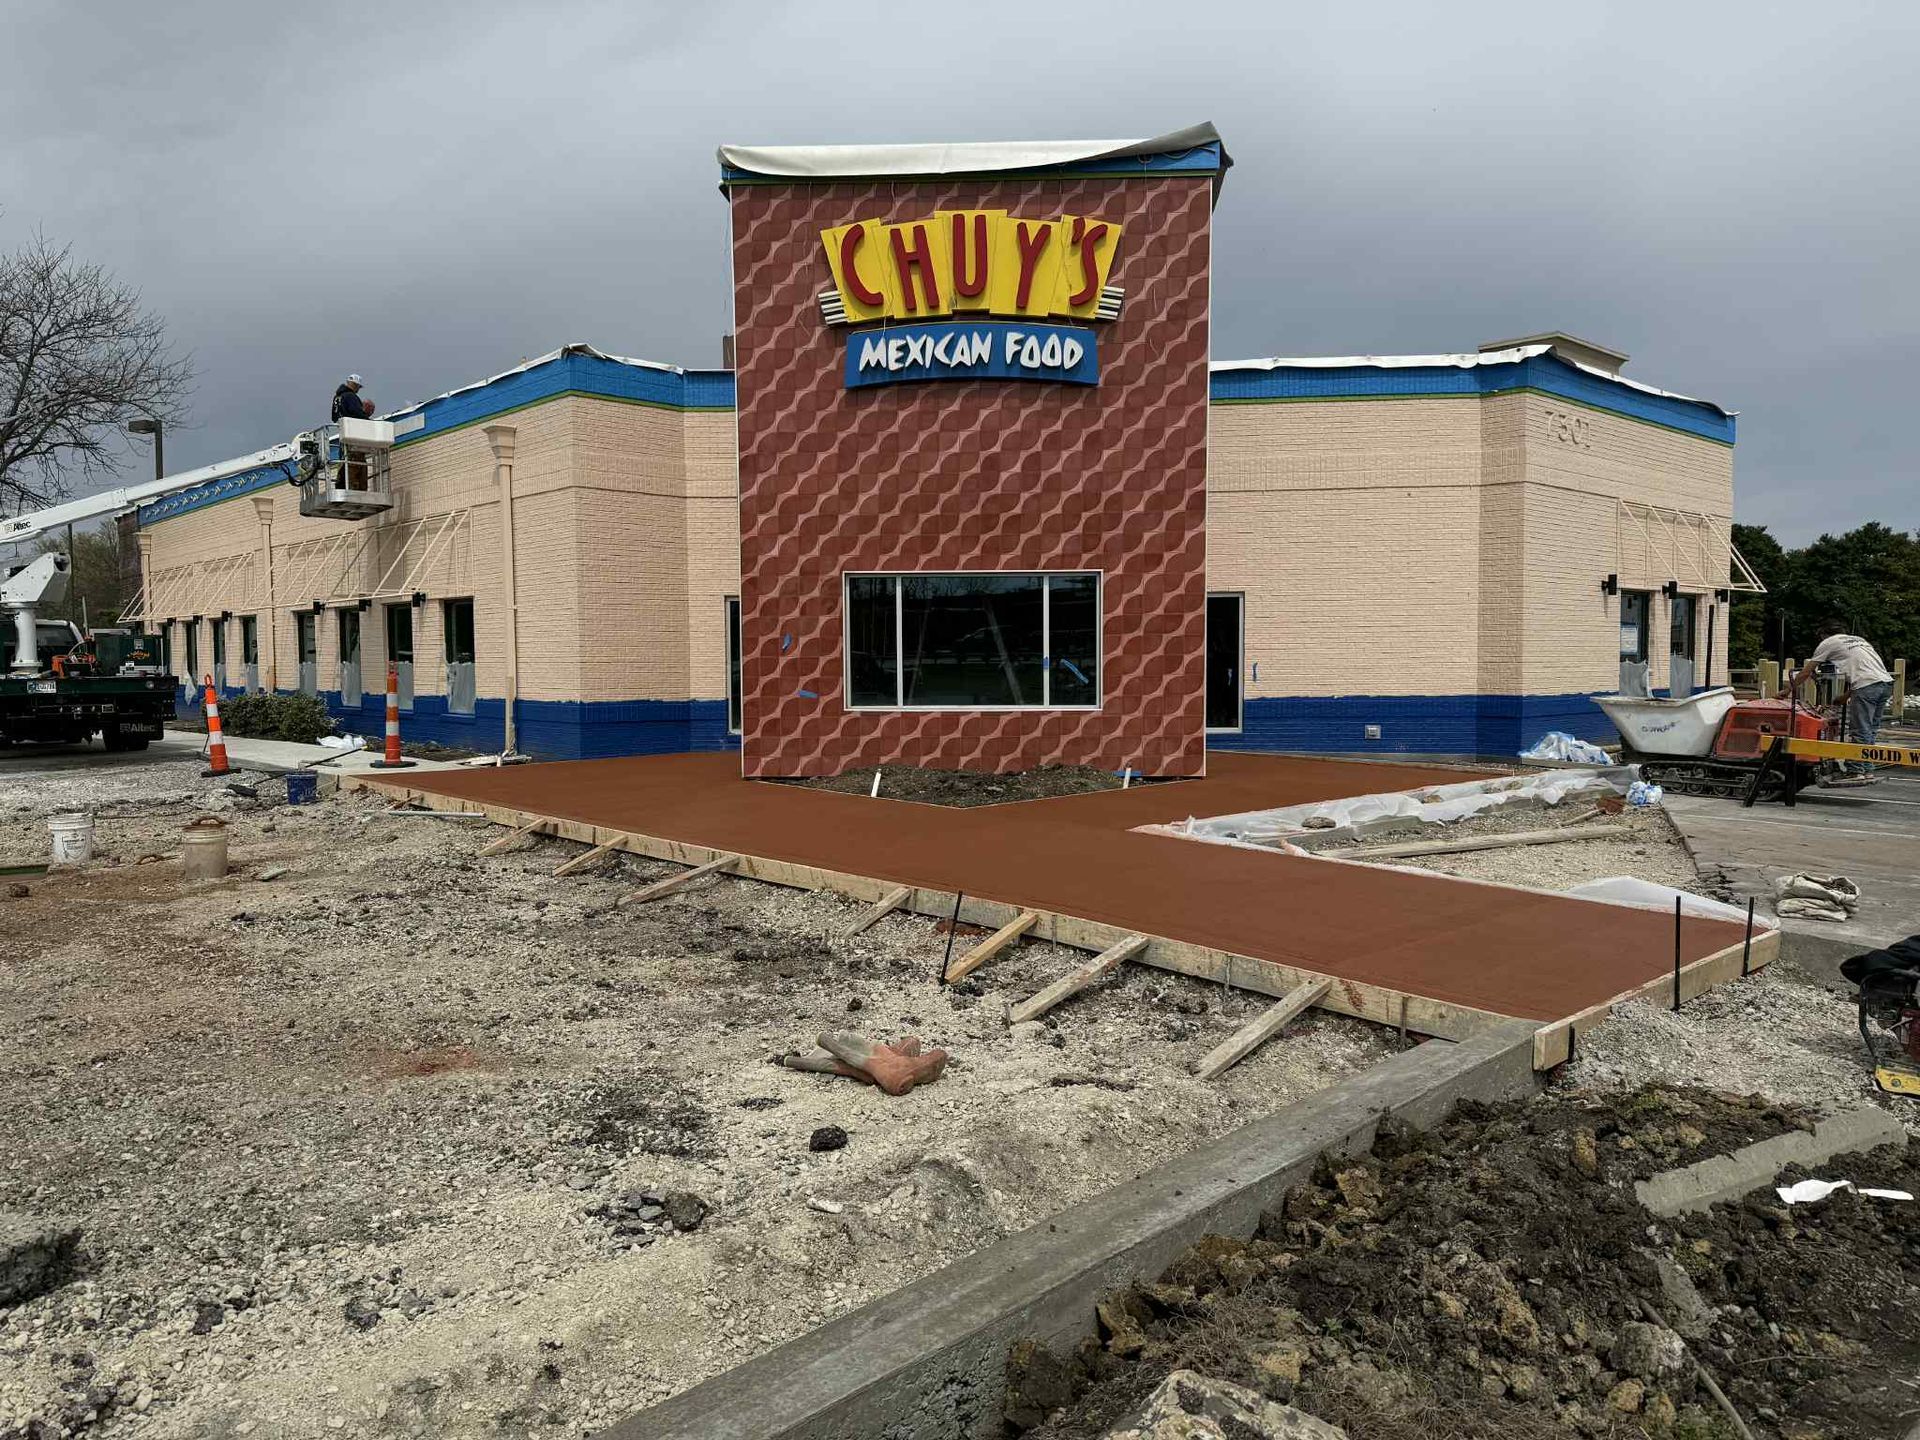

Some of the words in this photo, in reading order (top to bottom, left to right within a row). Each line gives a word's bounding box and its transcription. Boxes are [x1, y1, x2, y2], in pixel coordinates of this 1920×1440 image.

[841, 213, 1108, 311] CHUY'S
[859, 332, 992, 373] MEXICAN
[1006, 332, 1084, 370] FOOD
[130, 722, 155, 732] Altec
[1861, 748, 1902, 762] SOLID
